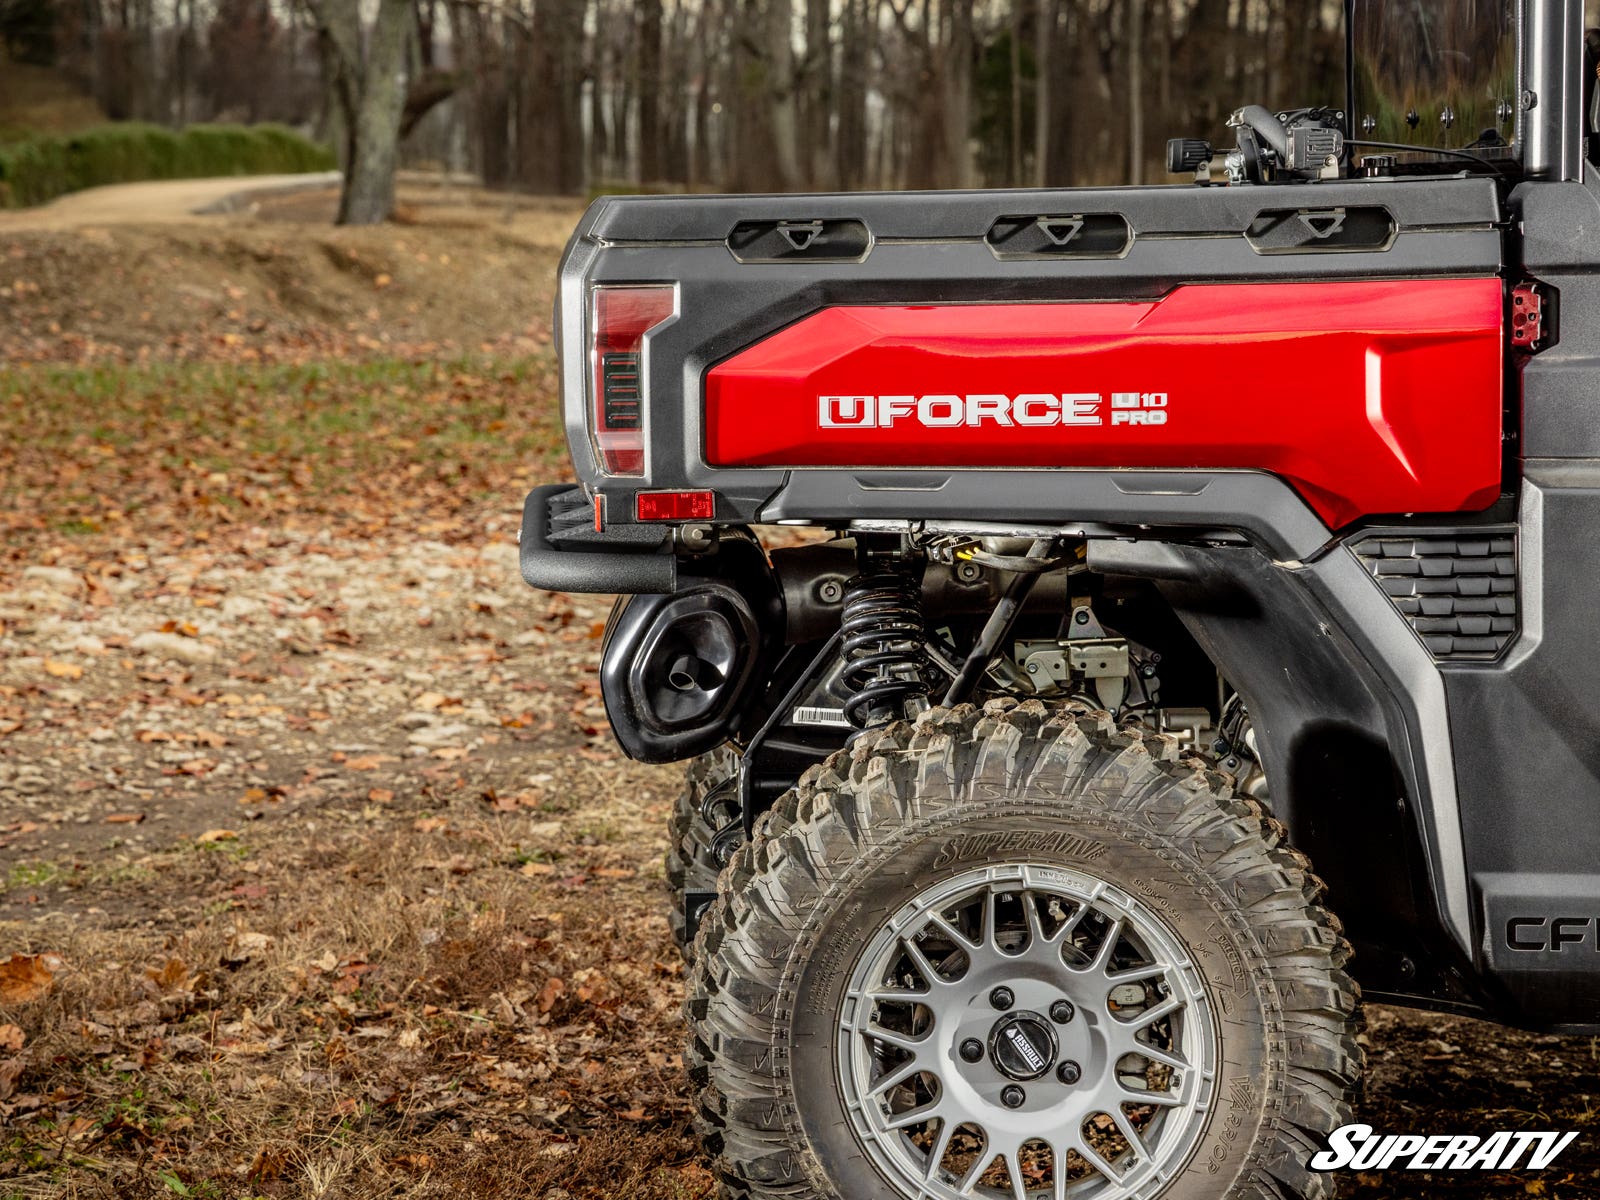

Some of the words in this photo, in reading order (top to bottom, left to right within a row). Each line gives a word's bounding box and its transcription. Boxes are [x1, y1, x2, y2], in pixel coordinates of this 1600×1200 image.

[818, 394, 1102, 427] UFORCE
[1111, 393, 1168, 408] U10
[1111, 410, 1168, 426] PRO
[1505, 917, 1600, 952] CF
[1217, 934, 1245, 981] DIRECTION
[1014, 1033, 1045, 1069] ASSAULT
